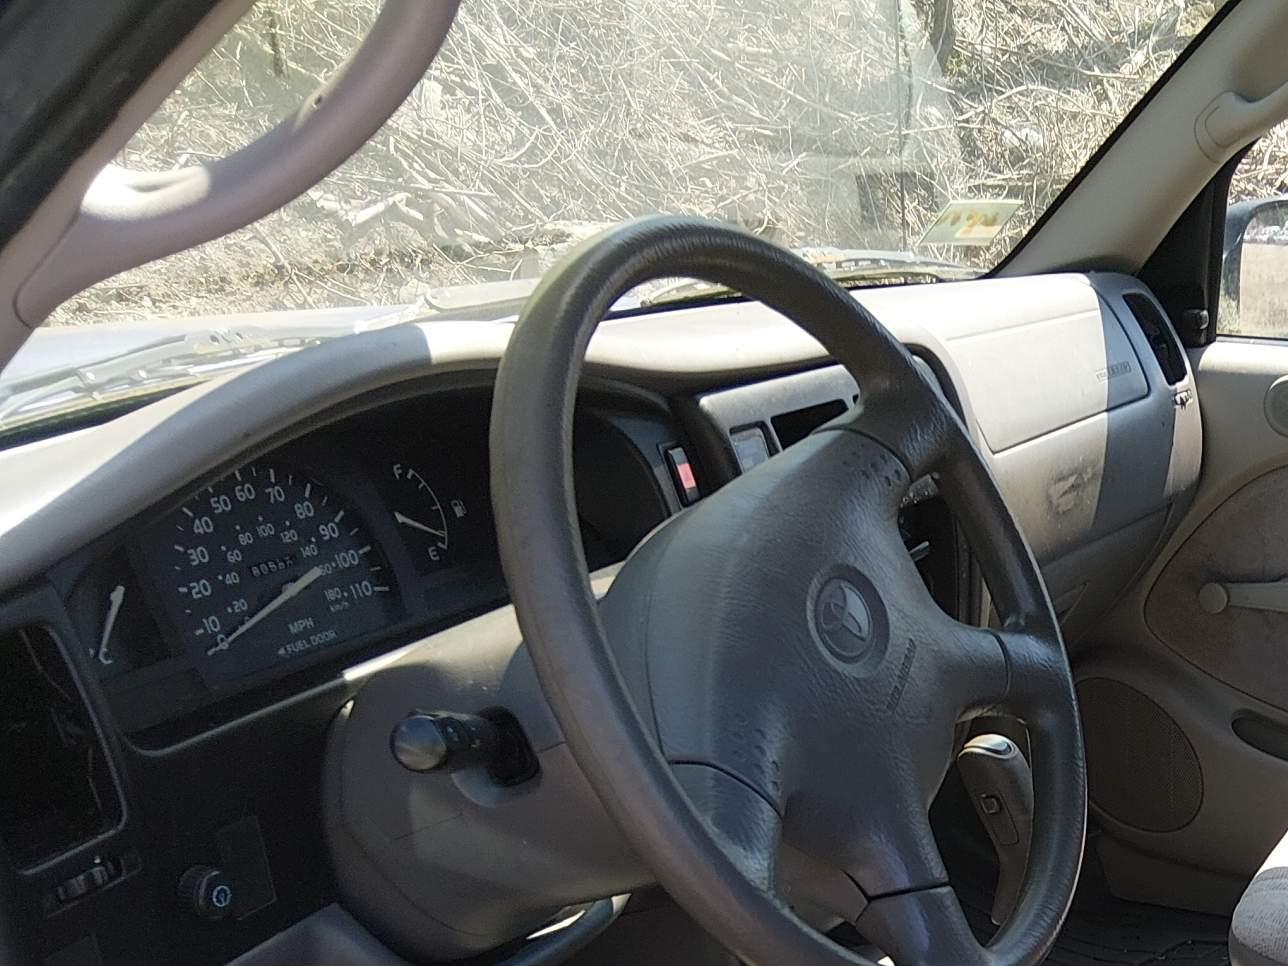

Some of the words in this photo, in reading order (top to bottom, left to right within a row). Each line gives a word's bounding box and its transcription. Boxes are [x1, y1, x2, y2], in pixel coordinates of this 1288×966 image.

[393, 464, 404, 480] F
[235, 483, 255, 500] 60
[265, 486, 285, 503] 70
[210, 495, 231, 513] 50
[295, 501, 315, 519] 80
[192, 517, 213, 534] 40
[256, 523, 275, 537] 100
[319, 522, 340, 540] 90
[238, 532, 253, 545] 80
[280, 530, 298, 543] 120
[188, 547, 209, 565] 30
[226, 549, 241, 563] 60
[300, 544, 318, 558] 140
[335, 550, 359, 568] 100
[428, 546, 440, 561] E
[224, 572, 240, 586] 40
[190, 580, 212, 598] 20
[324, 587, 342, 601] 180
[350, 580, 373, 599] 110
[233, 599, 248, 612] 20
[203, 615, 221, 634] 10
[288, 617, 314, 634] MPH
[285, 639, 311, 655] FUEL
[310, 629, 337, 646] DOOR
[98, 647, 113, 665] C
